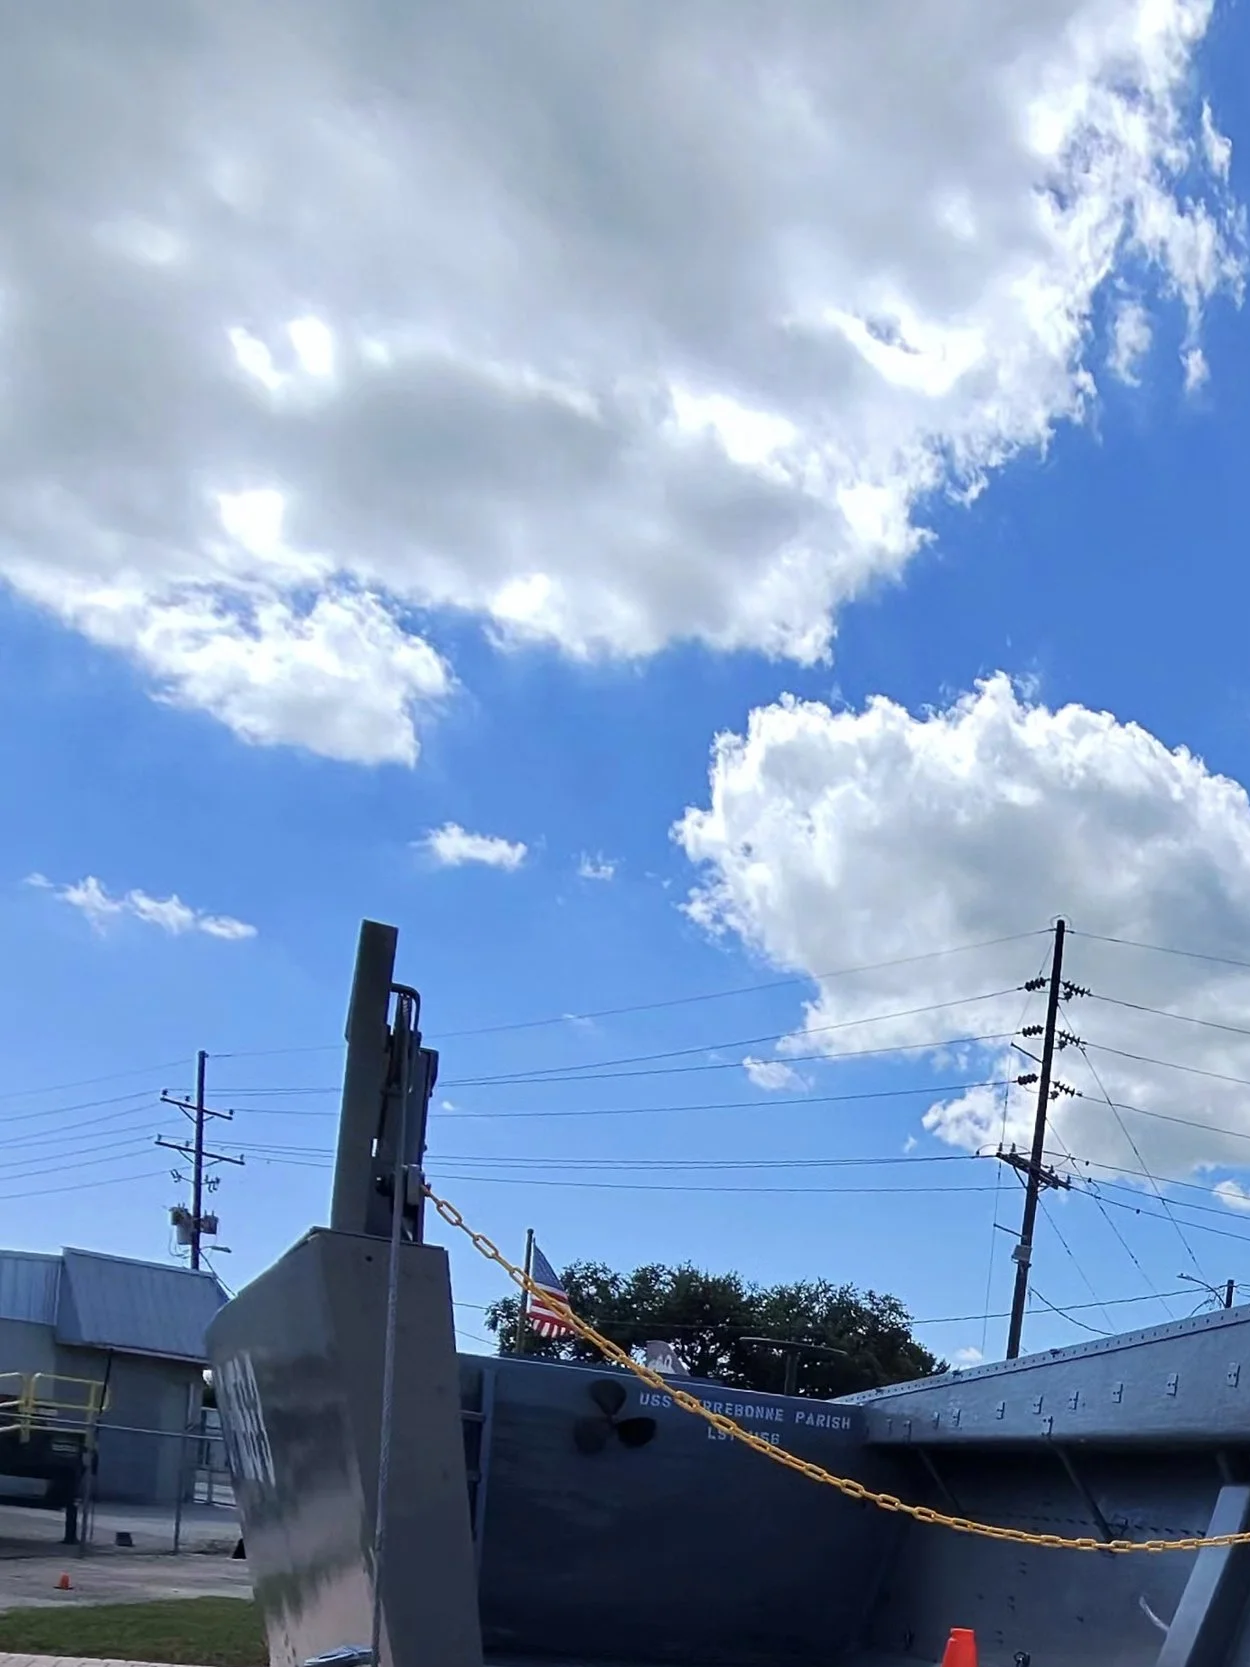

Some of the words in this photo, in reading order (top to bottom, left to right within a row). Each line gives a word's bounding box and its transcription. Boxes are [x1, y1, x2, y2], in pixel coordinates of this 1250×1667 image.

[640, 1391, 672, 1408] USS
[690, 1398, 784, 1422] RREBONNE
[795, 1411, 851, 1430] PARISH
